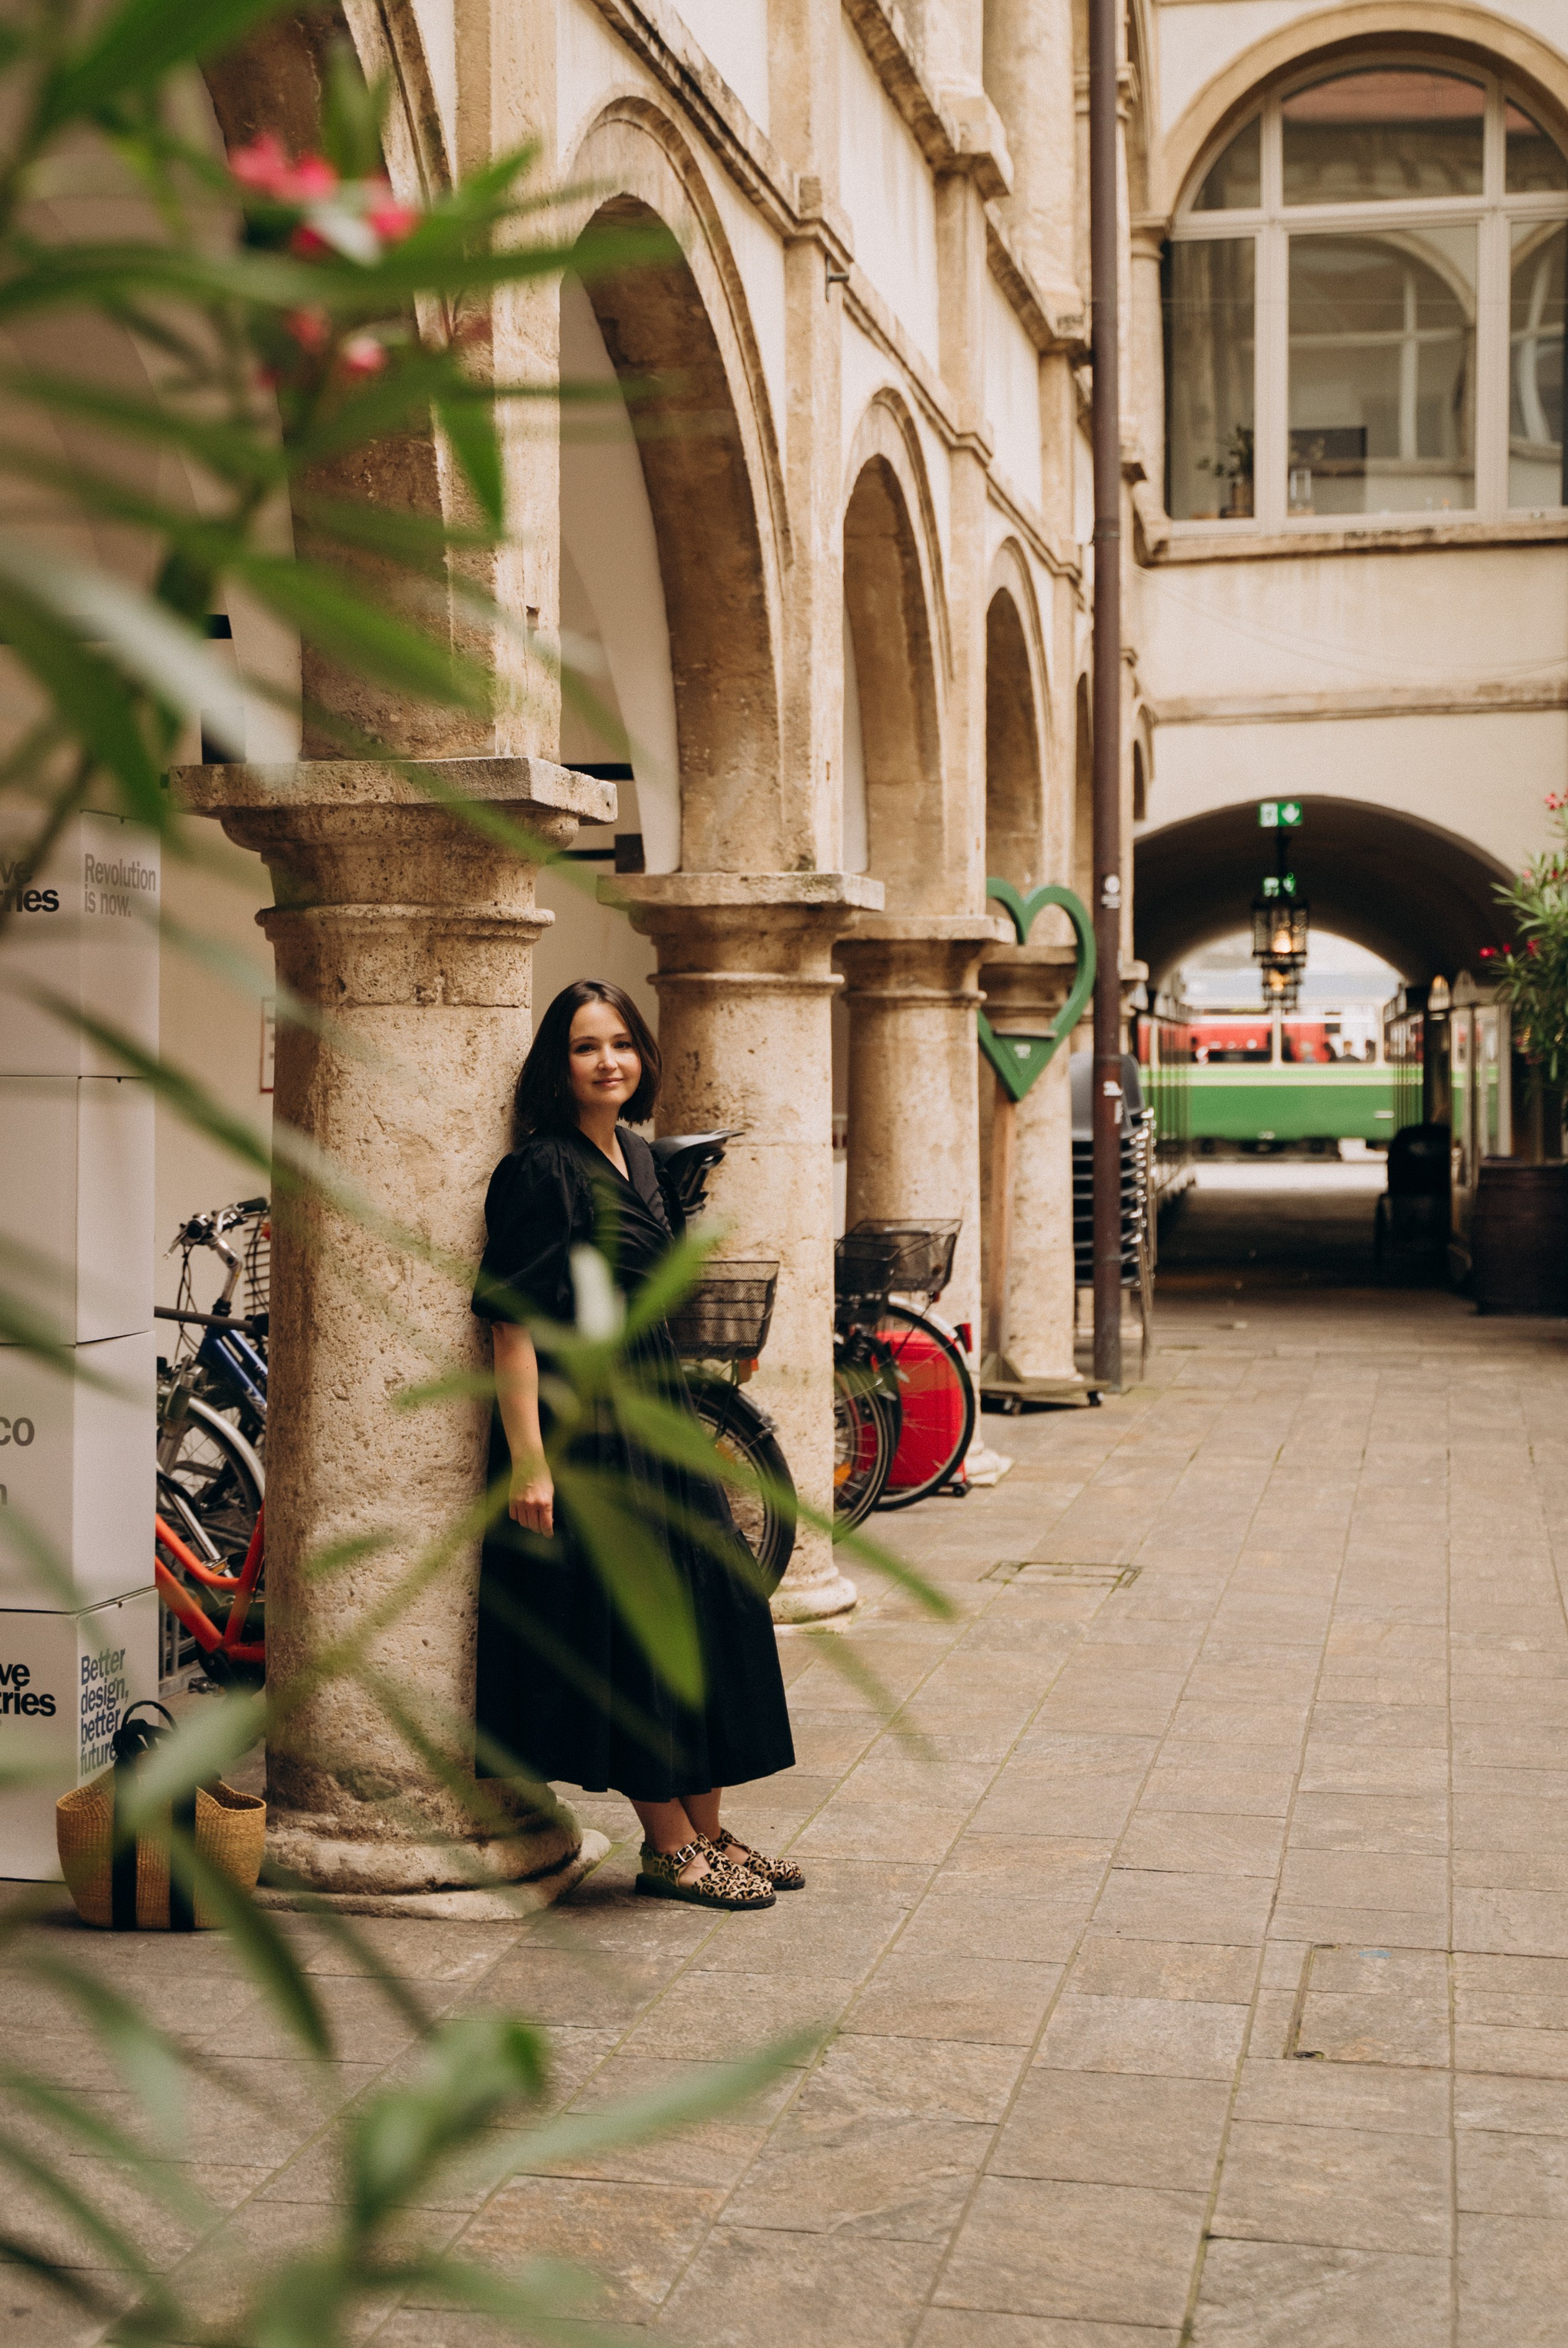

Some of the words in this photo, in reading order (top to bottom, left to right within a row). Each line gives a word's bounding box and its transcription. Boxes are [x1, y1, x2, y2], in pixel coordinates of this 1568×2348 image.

[85, 853, 156, 891] Revolution
[85, 883, 96, 913] is
[100, 893, 131, 917] now.
[81, 1648, 126, 1685] Better
[81, 1677, 129, 1715] design,
[81, 1708, 121, 1746] better
